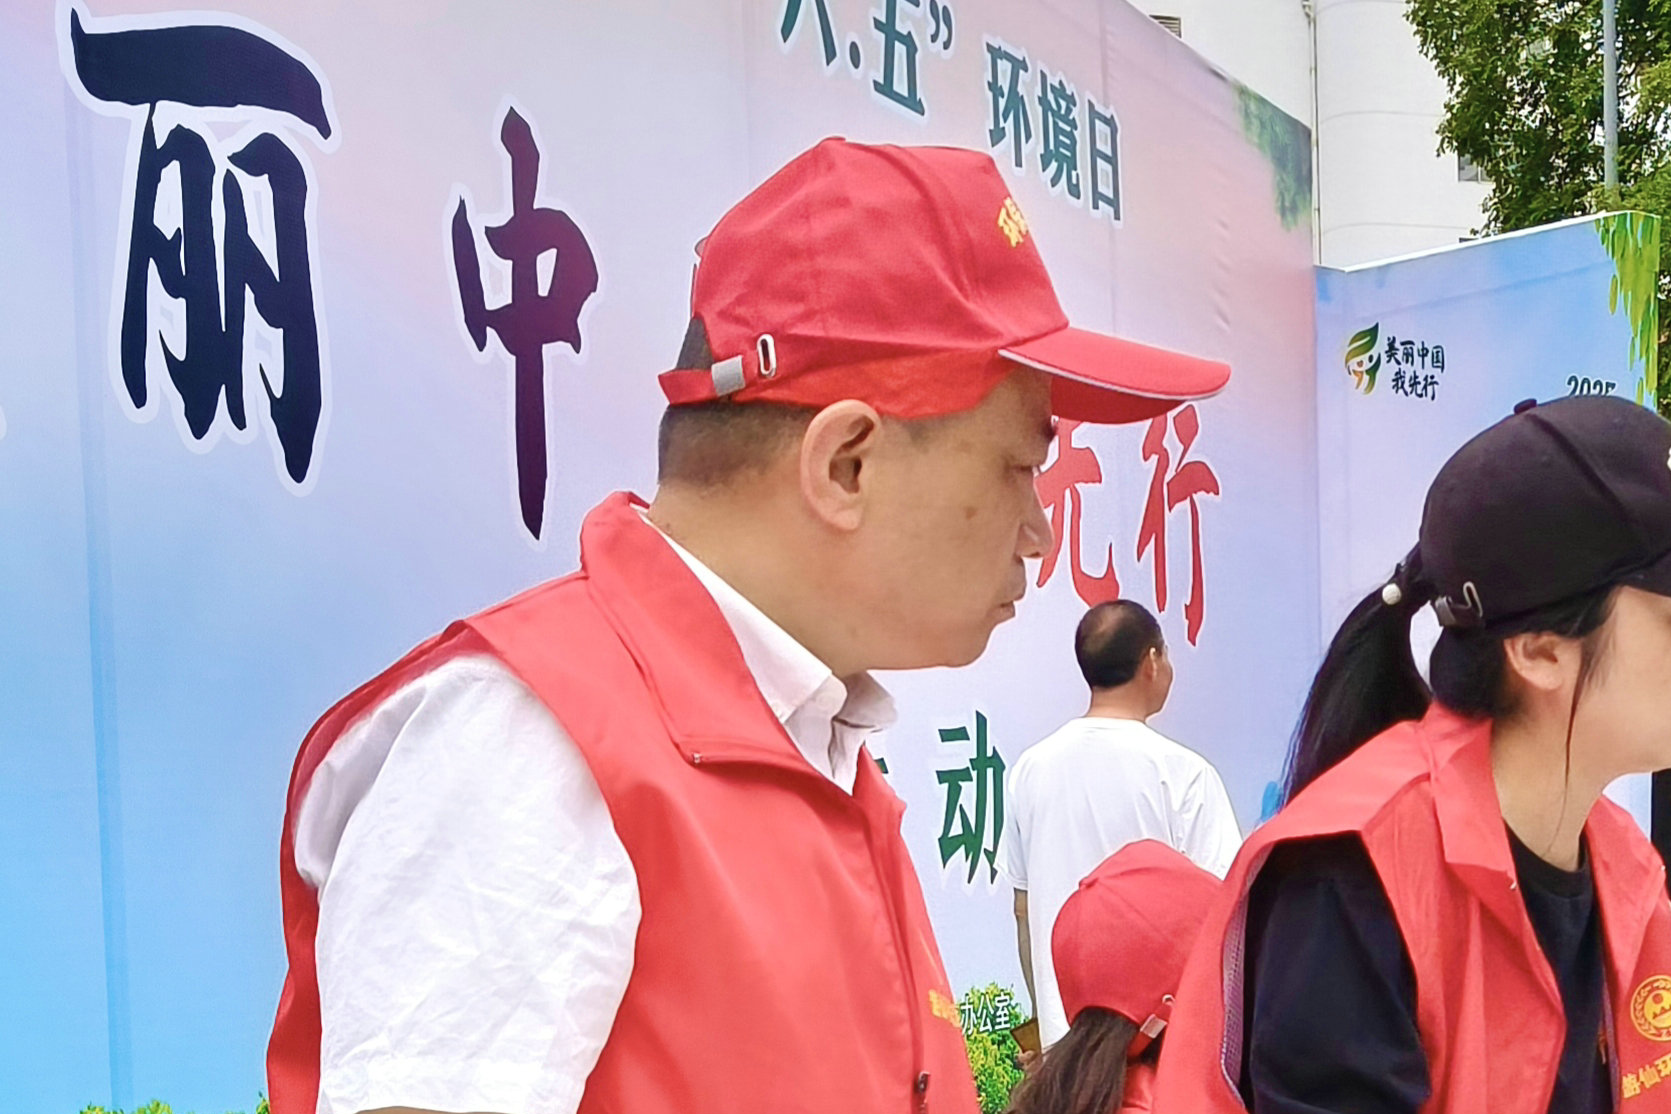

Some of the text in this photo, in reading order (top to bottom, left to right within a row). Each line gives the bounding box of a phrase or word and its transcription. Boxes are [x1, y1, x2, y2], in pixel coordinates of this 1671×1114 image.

[986, 42, 1122, 221] 环境日
[1385, 336, 1445, 374] 美丽中国
[1392, 367, 1439, 401] 我先行
[960, 991, 1011, 1036] 办公室
